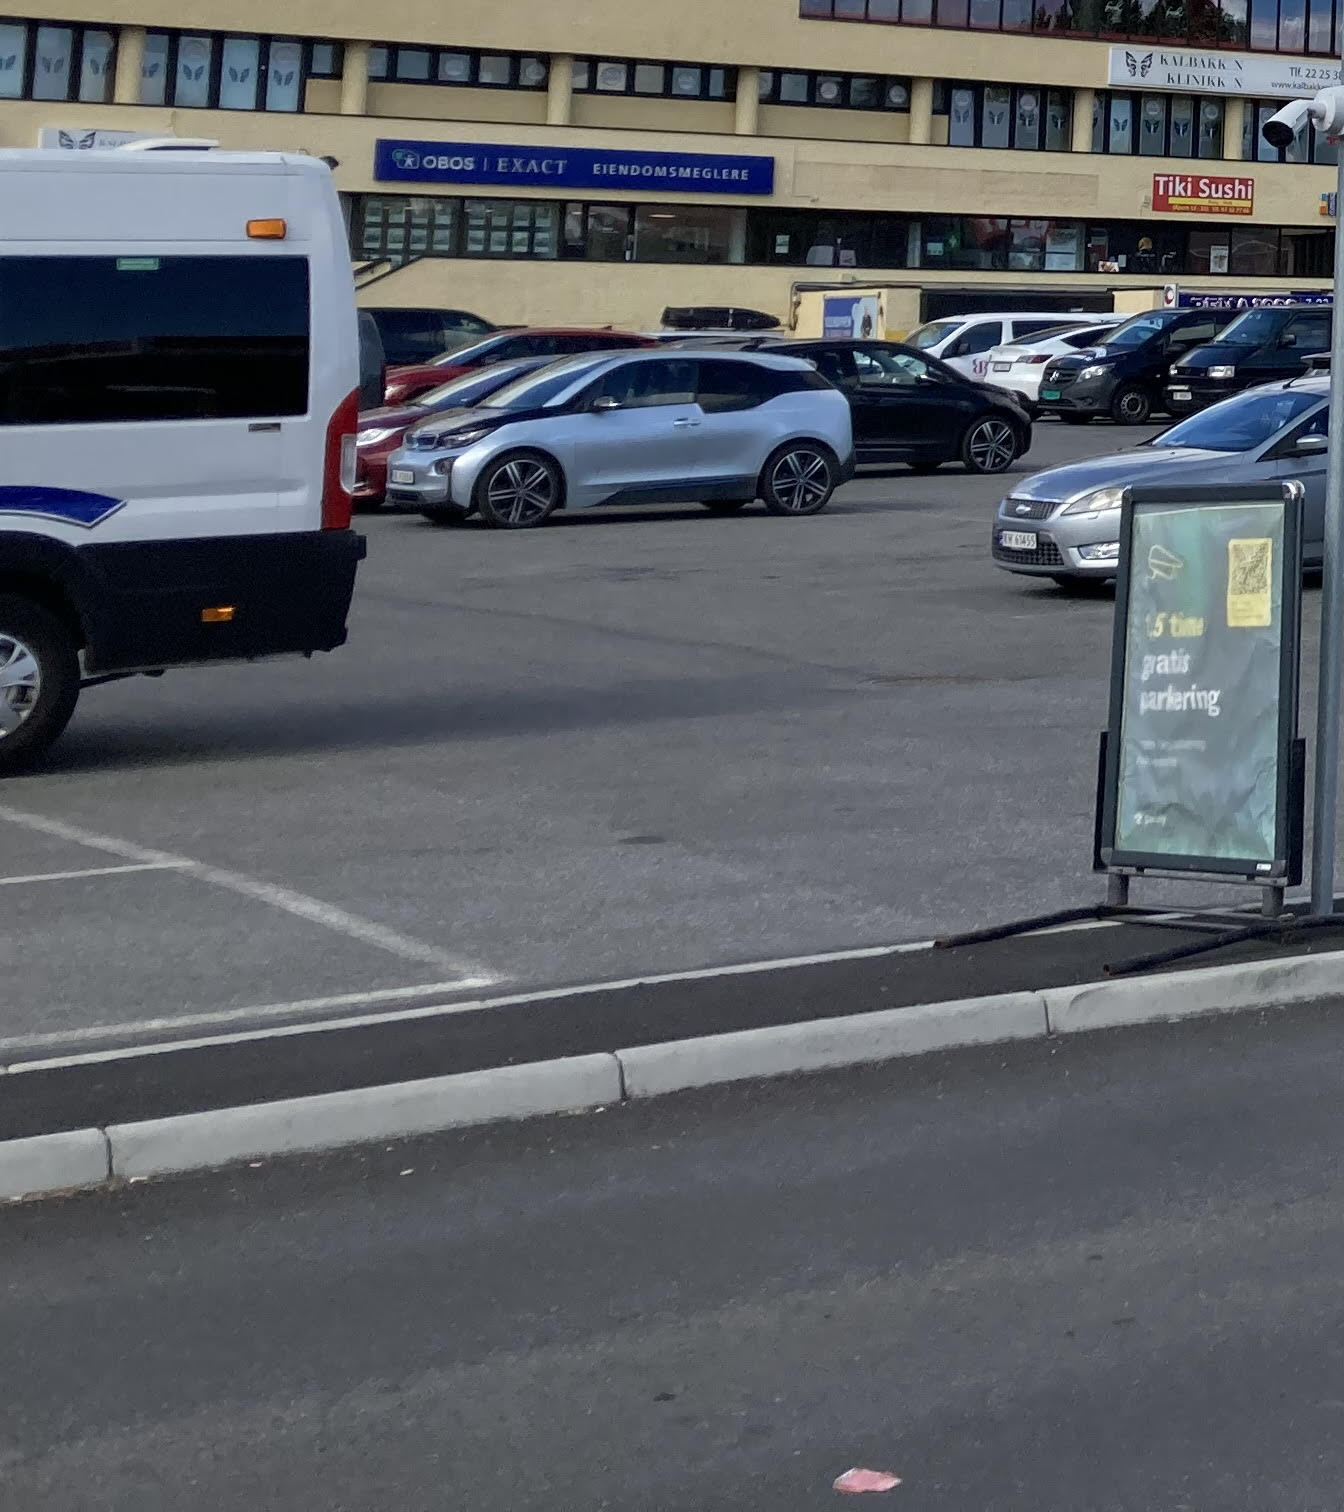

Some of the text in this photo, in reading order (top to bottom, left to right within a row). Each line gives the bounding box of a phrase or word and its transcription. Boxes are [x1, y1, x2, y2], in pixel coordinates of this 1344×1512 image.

[1160, 54, 1243, 71] KALBAKKN
[1305, 68, 1317, 79] 22
[1319, 69, 1331, 80] 25
[1166, 73, 1243, 88] KLINIKKN
[422, 155, 749, 180] OBOS EXACT EIENDOMSMEGLERE
[1155, 176, 1253, 200] Tiki Sushi
[1141, 648, 1191, 682] gratis
[1140, 684, 1221, 717] parkering
